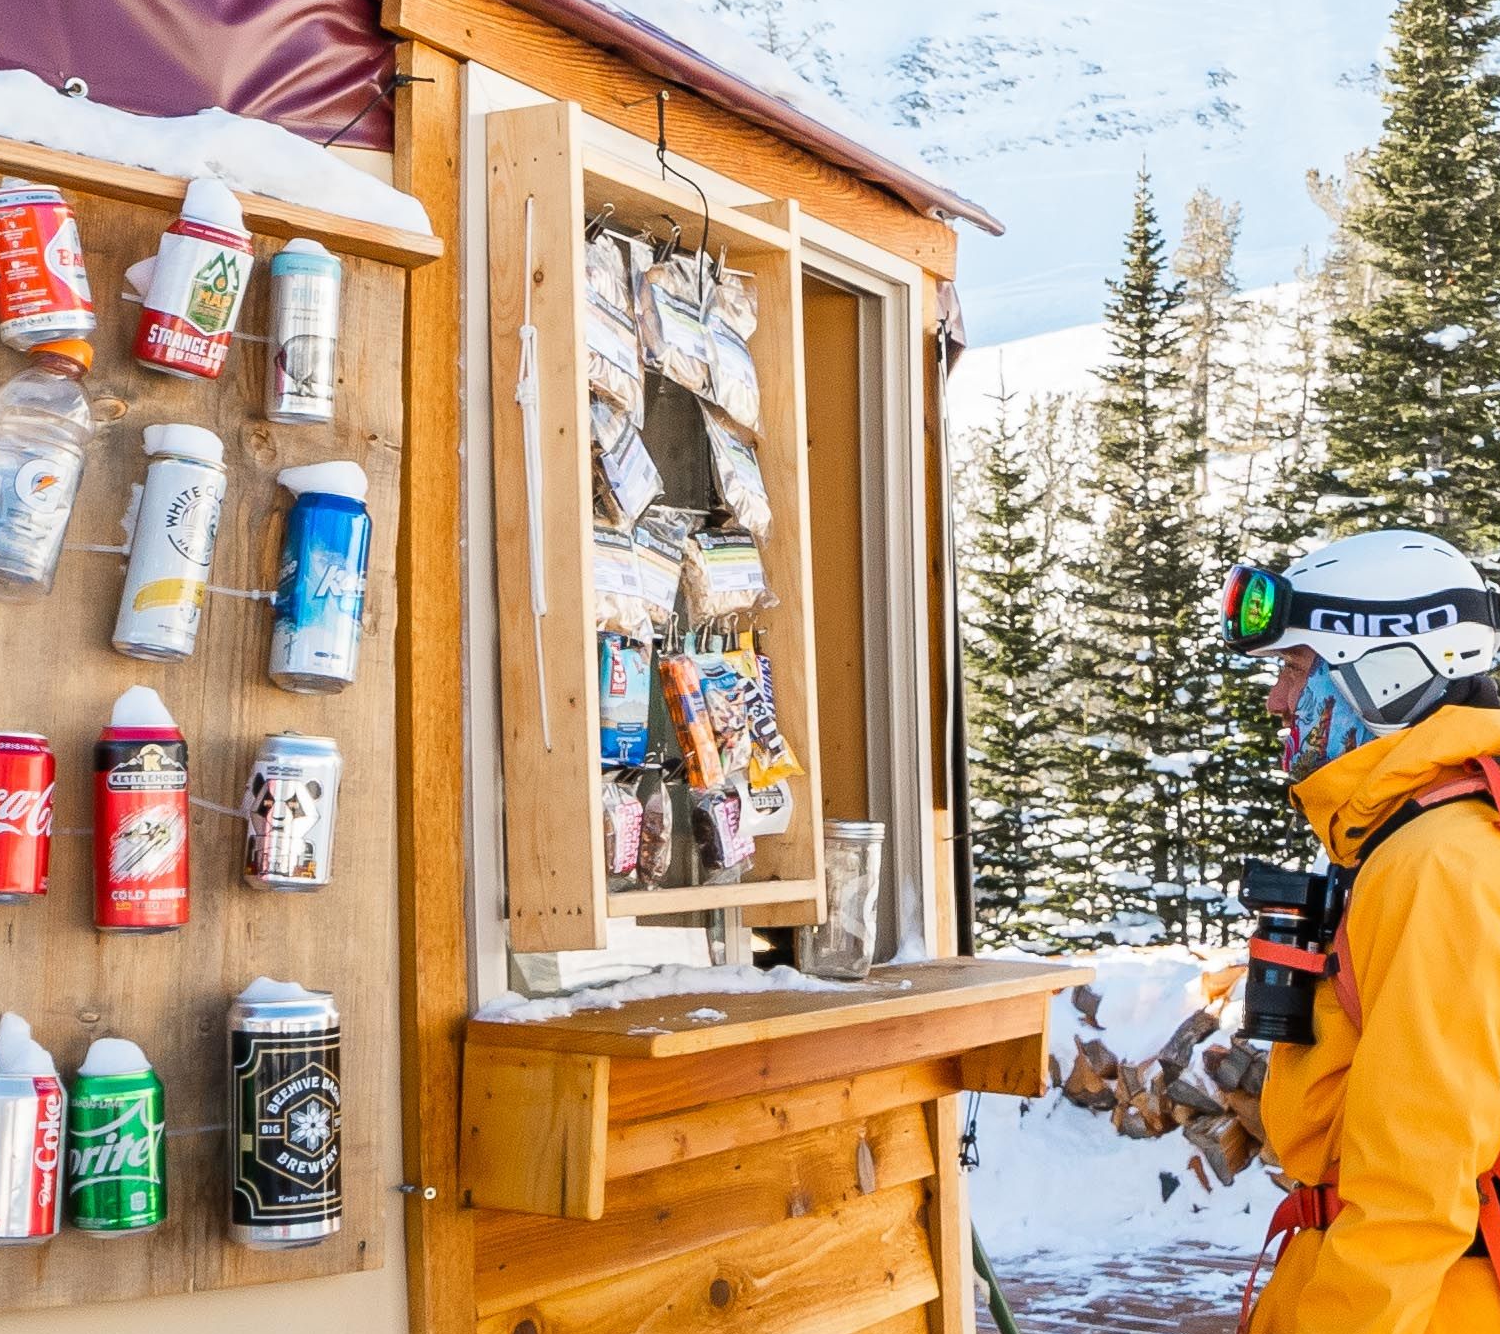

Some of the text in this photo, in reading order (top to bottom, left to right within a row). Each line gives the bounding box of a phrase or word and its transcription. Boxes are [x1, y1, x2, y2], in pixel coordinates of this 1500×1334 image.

[148, 324, 209, 355] STRANGE
[166, 485, 201, 528] WHITE
[1310, 604, 1458, 637] GIRO
[112, 774, 185, 784] KETTLEHOUSE
[111, 890, 145, 901] COLD
[267, 1075, 320, 1115] BEEHIVE
[35, 1094, 62, 1171] Coke
[261, 1123, 281, 1134] BIG
[276, 1144, 339, 1175] BREWERY
[278, 1194, 298, 1204] Keep
